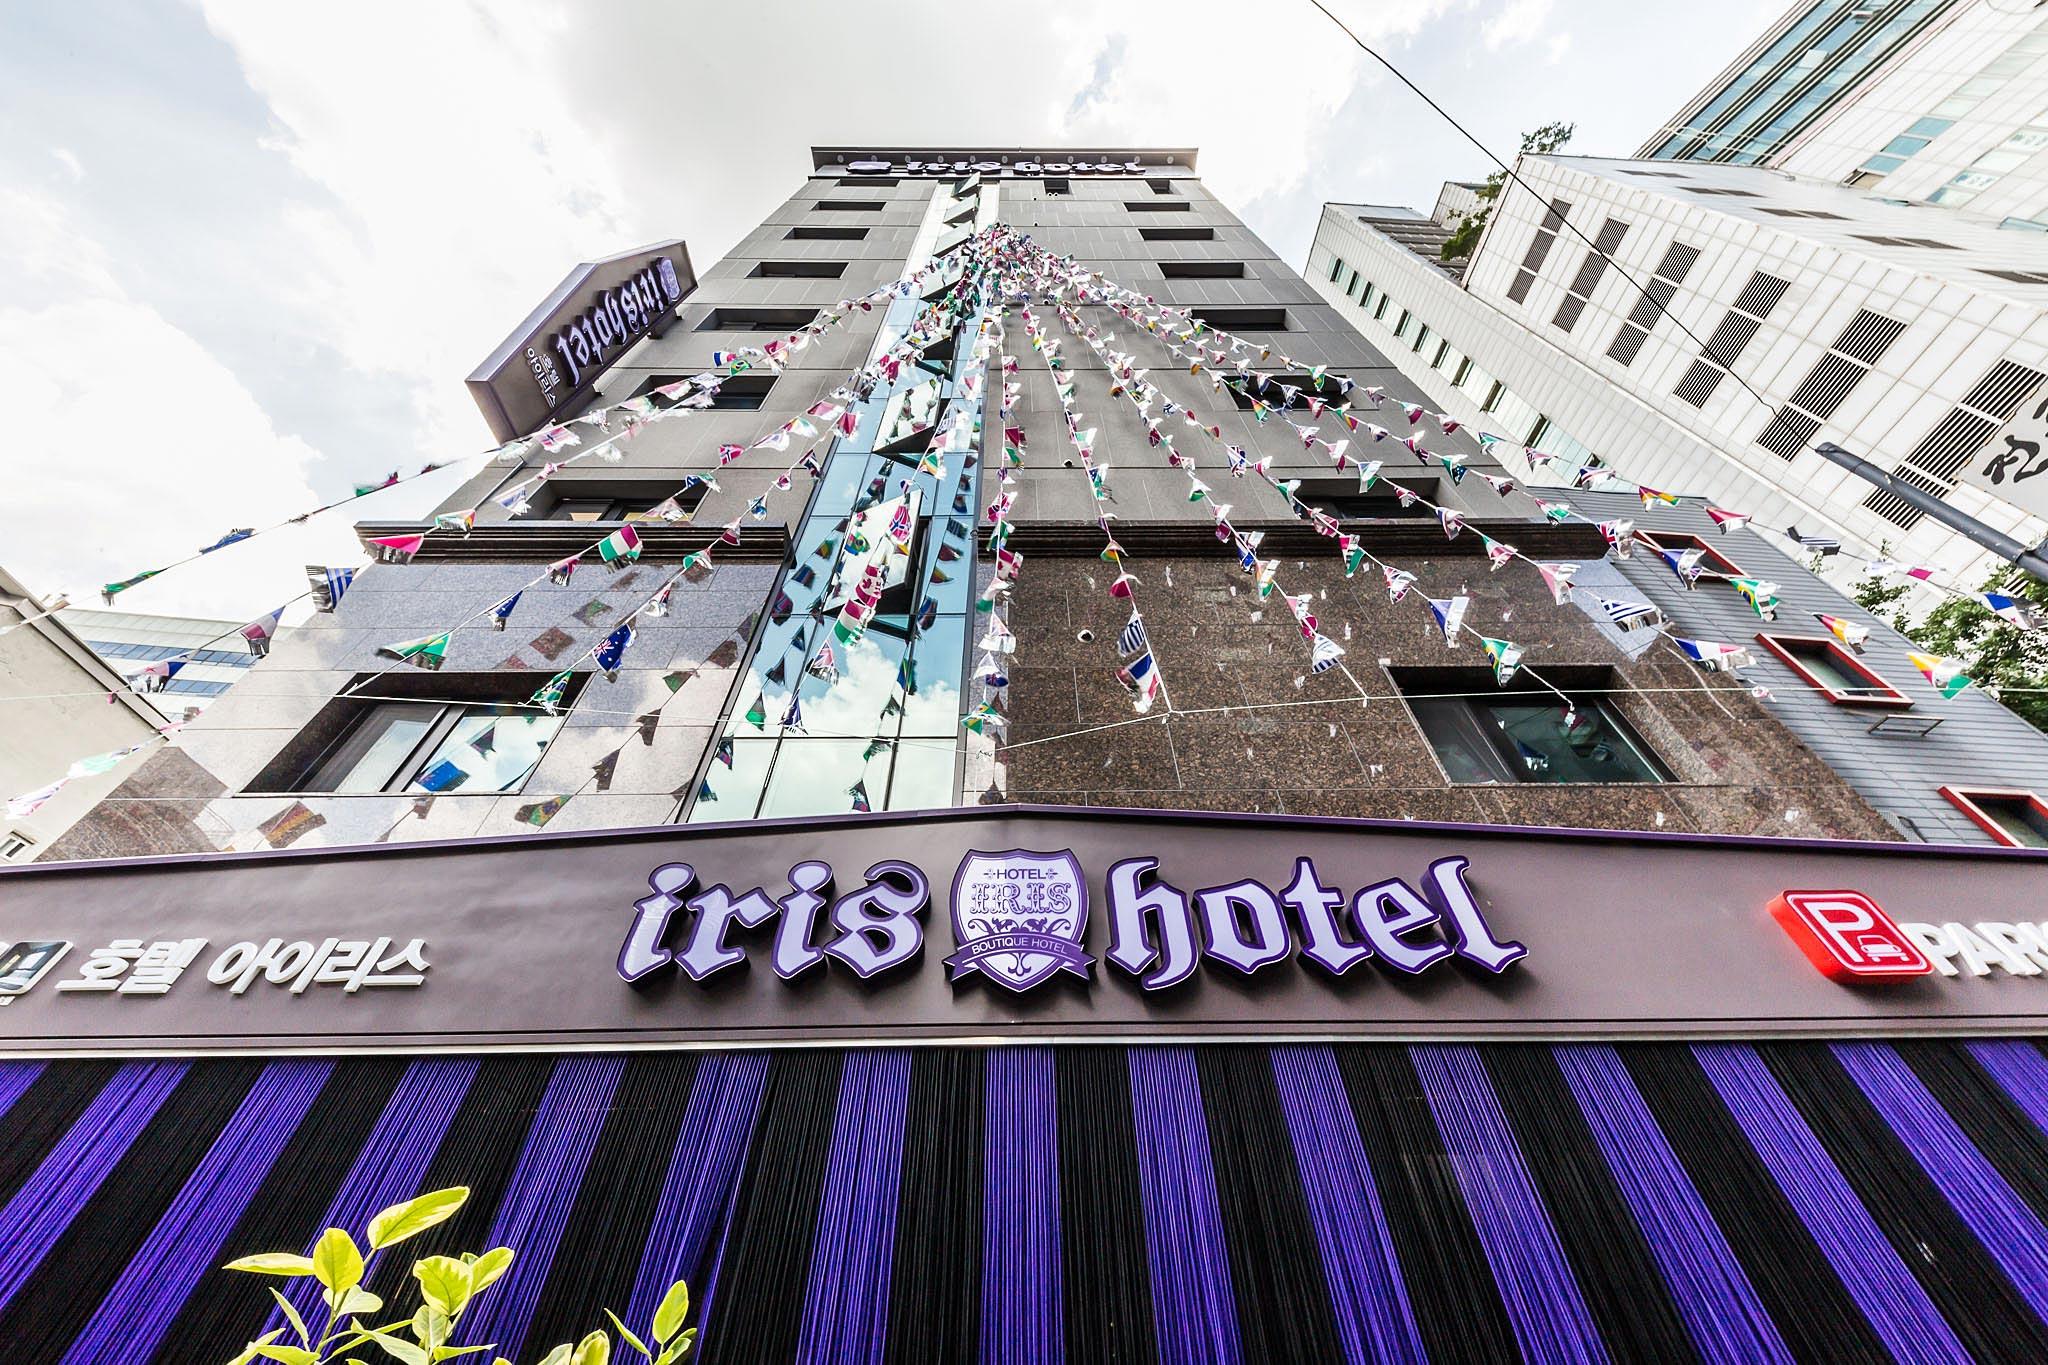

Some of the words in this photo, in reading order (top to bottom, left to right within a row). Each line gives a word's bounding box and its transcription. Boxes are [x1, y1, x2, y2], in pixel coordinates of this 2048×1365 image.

[526, 347, 557, 408] 아이리스
[969, 882, 1072, 914] IRIS
[996, 868, 1047, 880] HOTEL
[616, 859, 930, 983] iris
[1104, 855, 1529, 991] hotel
[971, 936, 1029, 955] BOUTIQUE
[1031, 938, 1068, 955] HOTEL
[1802, 901, 1874, 963] P
[54, 938, 209, 995] 호텔
[206, 937, 431, 995] 아이리스
